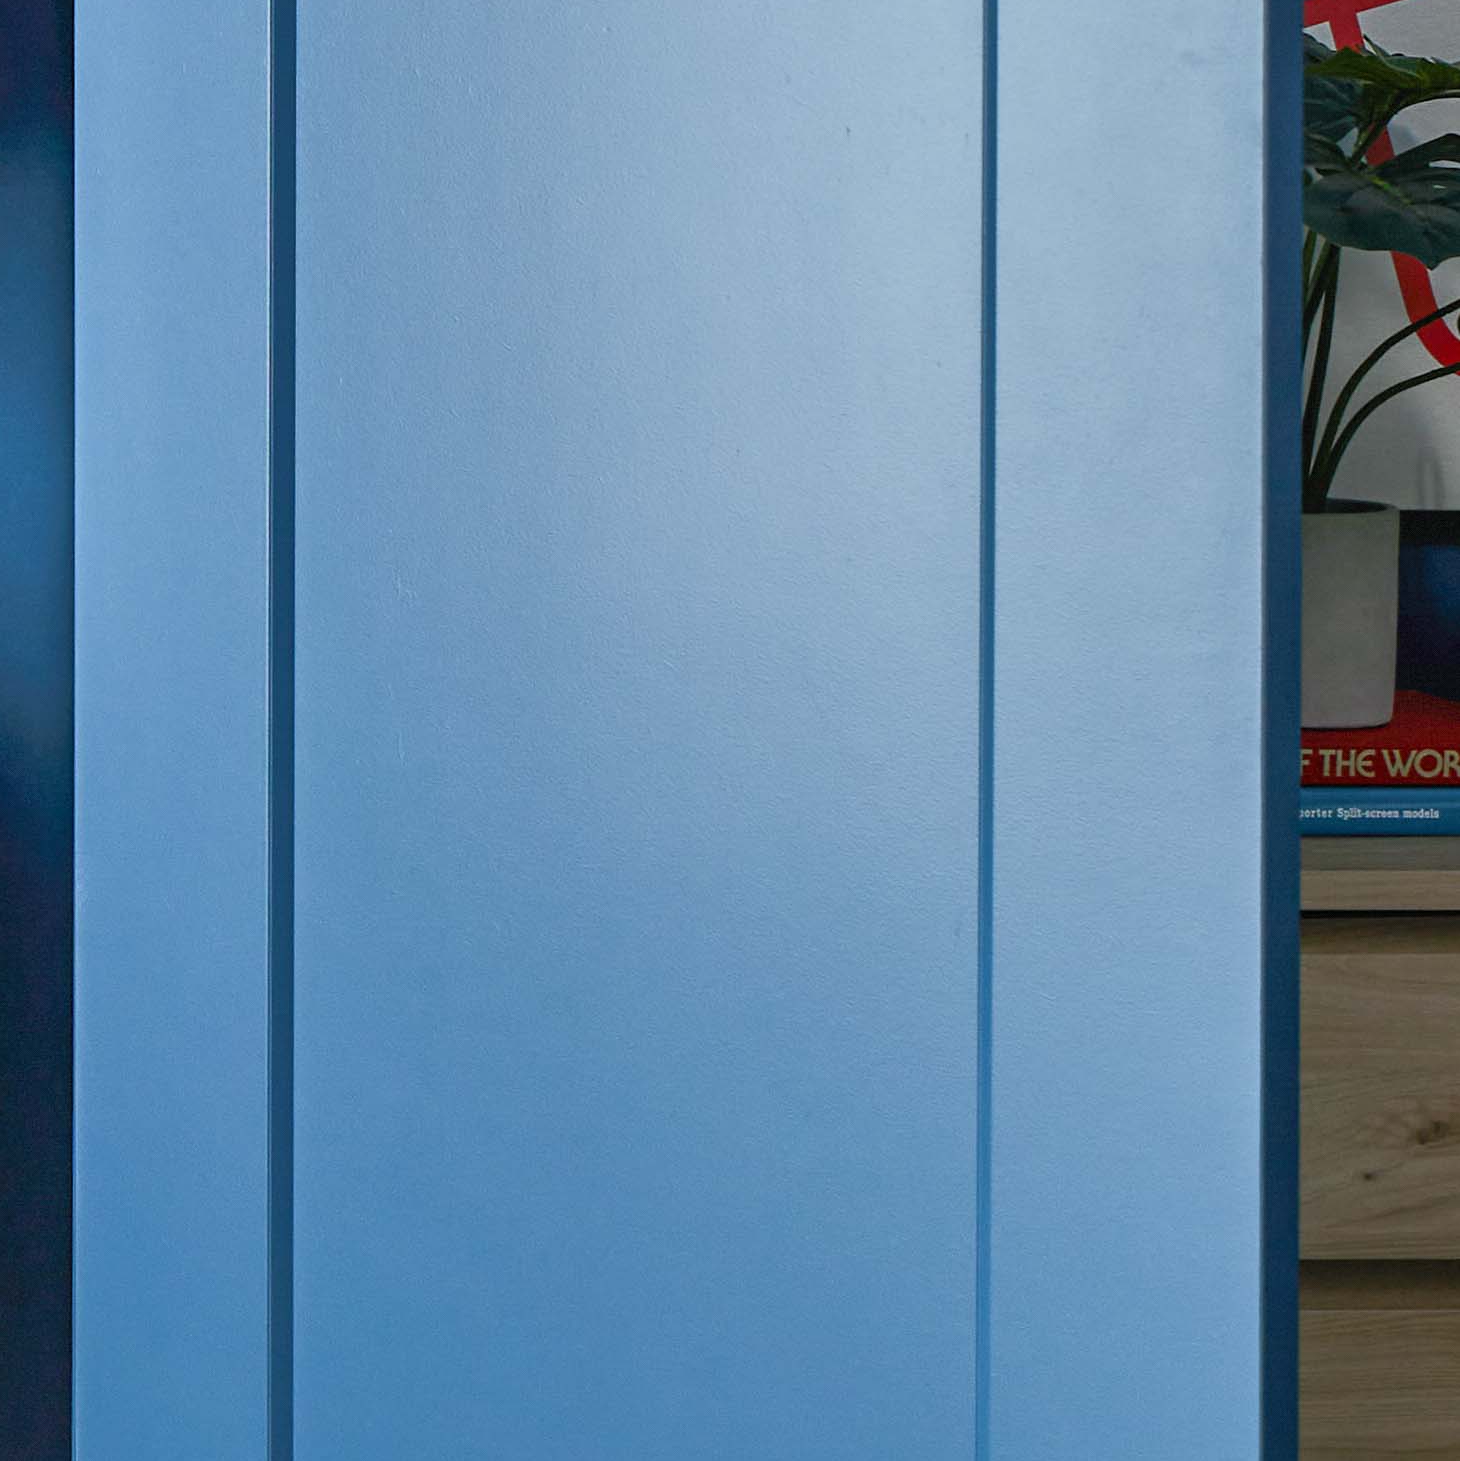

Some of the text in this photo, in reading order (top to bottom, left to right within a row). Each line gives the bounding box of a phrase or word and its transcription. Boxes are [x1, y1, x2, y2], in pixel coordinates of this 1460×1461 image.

[1319, 749, 1376, 777] THE
[1382, 749, 1460, 778] WOR
[1337, 807, 1399, 820] Split-screen
[1403, 808, 1439, 819] models
